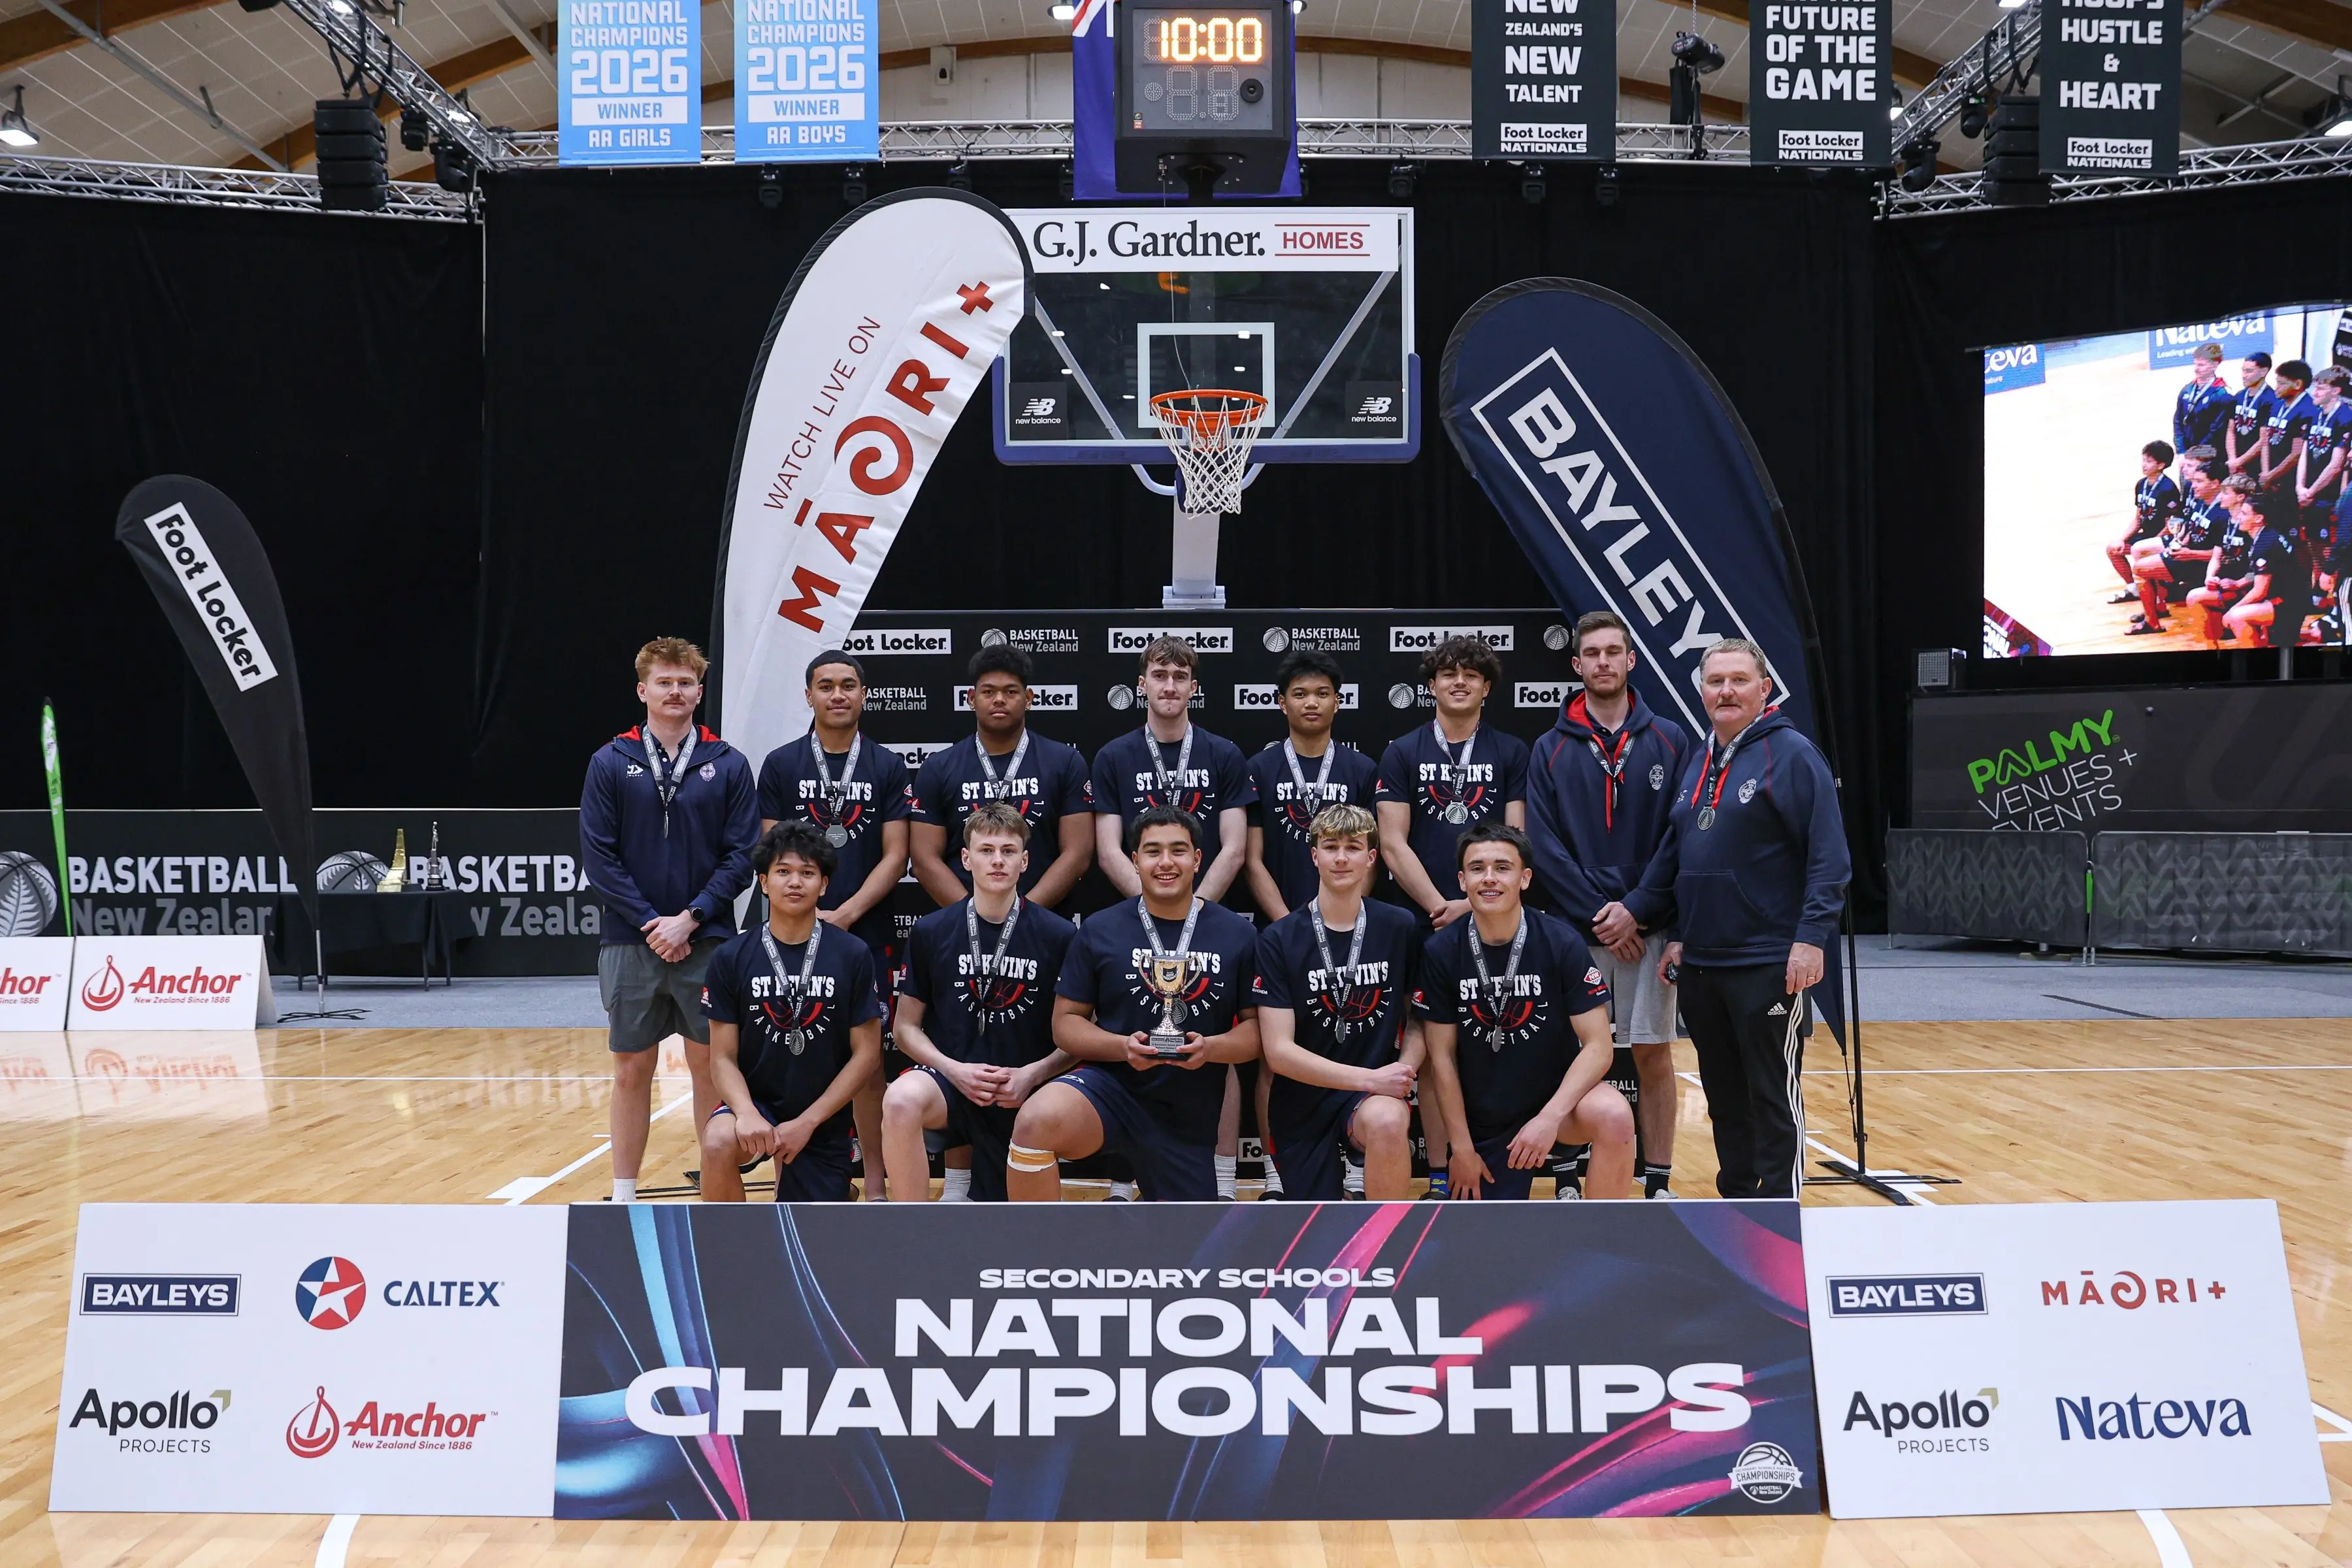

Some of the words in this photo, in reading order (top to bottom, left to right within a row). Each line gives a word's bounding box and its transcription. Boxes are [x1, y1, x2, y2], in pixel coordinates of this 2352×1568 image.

[570, 1, 687, 25] NATIONAL
[747, 0, 864, 22] NATIONAL
[1766, 5, 1876, 30] FUTURE
[571, 25, 687, 47] CHAMPIONS
[747, 22, 864, 44] CHAMPIONS
[1160, 17, 1263, 61] 10:00
[1505, 23, 1582, 37] ZEALAND'S
[2061, 18, 2163, 44] HUSTLE
[1505, 46, 1581, 75] NEW
[1766, 35, 1805, 63] OF
[1814, 35, 1876, 64] THE
[571, 48, 688, 94] 2026
[747, 45, 864, 91] 2026
[2104, 54, 2120, 73] &
[1505, 84, 1582, 103] TALENT
[1766, 68, 1876, 101] GAME
[2059, 80, 2161, 110] HEART
[598, 103, 662, 119] WINNER
[774, 100, 839, 116] WINNER
[589, 129, 612, 148] AA
[619, 128, 671, 146] GIRLS
[766, 127, 791, 144] AA
[798, 125, 846, 144] BOYS
[1505, 127, 1534, 139] Foot
[1537, 126, 1584, 139] Locker
[1782, 133, 1811, 145] Foot
[1815, 133, 1861, 146] Locker
[1501, 142, 1587, 154] NATIONALS
[1778, 149, 1863, 161] NATIONALS
[2071, 142, 2100, 154] Foot
[2104, 142, 2149, 155] Locker
[2067, 157, 2152, 169] NATIONALS
[1033, 221, 1097, 266] G.J.
[1108, 220, 1266, 257] Gardner.
[1282, 231, 1364, 250] HOMES
[764, 421, 822, 512] WATCH
[812, 359, 856, 417] LIVE
[848, 316, 881, 354] ON
[1368, 414, 1397, 423] balance
[1508, 387, 1723, 694] BAYLEY
[156, 514, 209, 580] Foot
[197, 581, 261, 678] Locker
[841, 635, 875, 651] oot
[1010, 629, 1079, 640] BASKETBALL
[1113, 632, 1154, 648] Foot
[1292, 628, 1360, 640] BASKETBALL
[1395, 631, 1437, 647] Foot
[1010, 641, 1034, 652] New
[1036, 640, 1079, 652] Zealand
[1292, 640, 1315, 651] New
[1317, 640, 1360, 651] Zealand
[866, 687, 926, 698] ASKETBALL
[1520, 687, 1560, 703] Foot
[885, 699, 926, 711] Zealand
[1967, 710, 2113, 793] PALMY
[1135, 772, 1153, 791] ST
[1419, 763, 1436, 781] ST
[799, 780, 817, 798] ST
[962, 781, 979, 800] ST
[1277, 781, 1293, 800] ST
[1978, 755, 2113, 819] VENUES
[67, 856, 299, 893] BASKETBALL
[72, 898, 146, 936] New
[500, 896, 600, 936] Zeala
[958, 955, 975, 975] ST
[128, 967, 241, 994] Anchor
[751, 976, 771, 998] ST
[1308, 968, 1327, 992] ST
[1460, 978, 1478, 1000] ST
[979, 1269, 1211, 1290] SECONDARY
[1218, 1267, 1396, 1288] SCHOOLS
[92, 1284, 229, 1307] BAYLEYS
[384, 1281, 500, 1307] CALTEX
[1838, 1282, 1976, 1308] BAYLEYS
[894, 1297, 1483, 1358] NATIONAL
[625, 1363, 1752, 1437] CHAMPIONSHIPS
[69, 1388, 218, 1436] Apollo
[343, 1401, 486, 1437] Anchor
[1843, 1388, 1989, 1437] Apollo
[2055, 1392, 2251, 1441] Nateva
[120, 1439, 210, 1453] PROJECTS
[352, 1440, 374, 1448] New
[376, 1440, 416, 1449] Zealand
[448, 1441, 472, 1450] 1886
[1898, 1439, 1989, 1454] PROJECTS
[1736, 1471, 1795, 1482] CHAMPIONSHIPS
